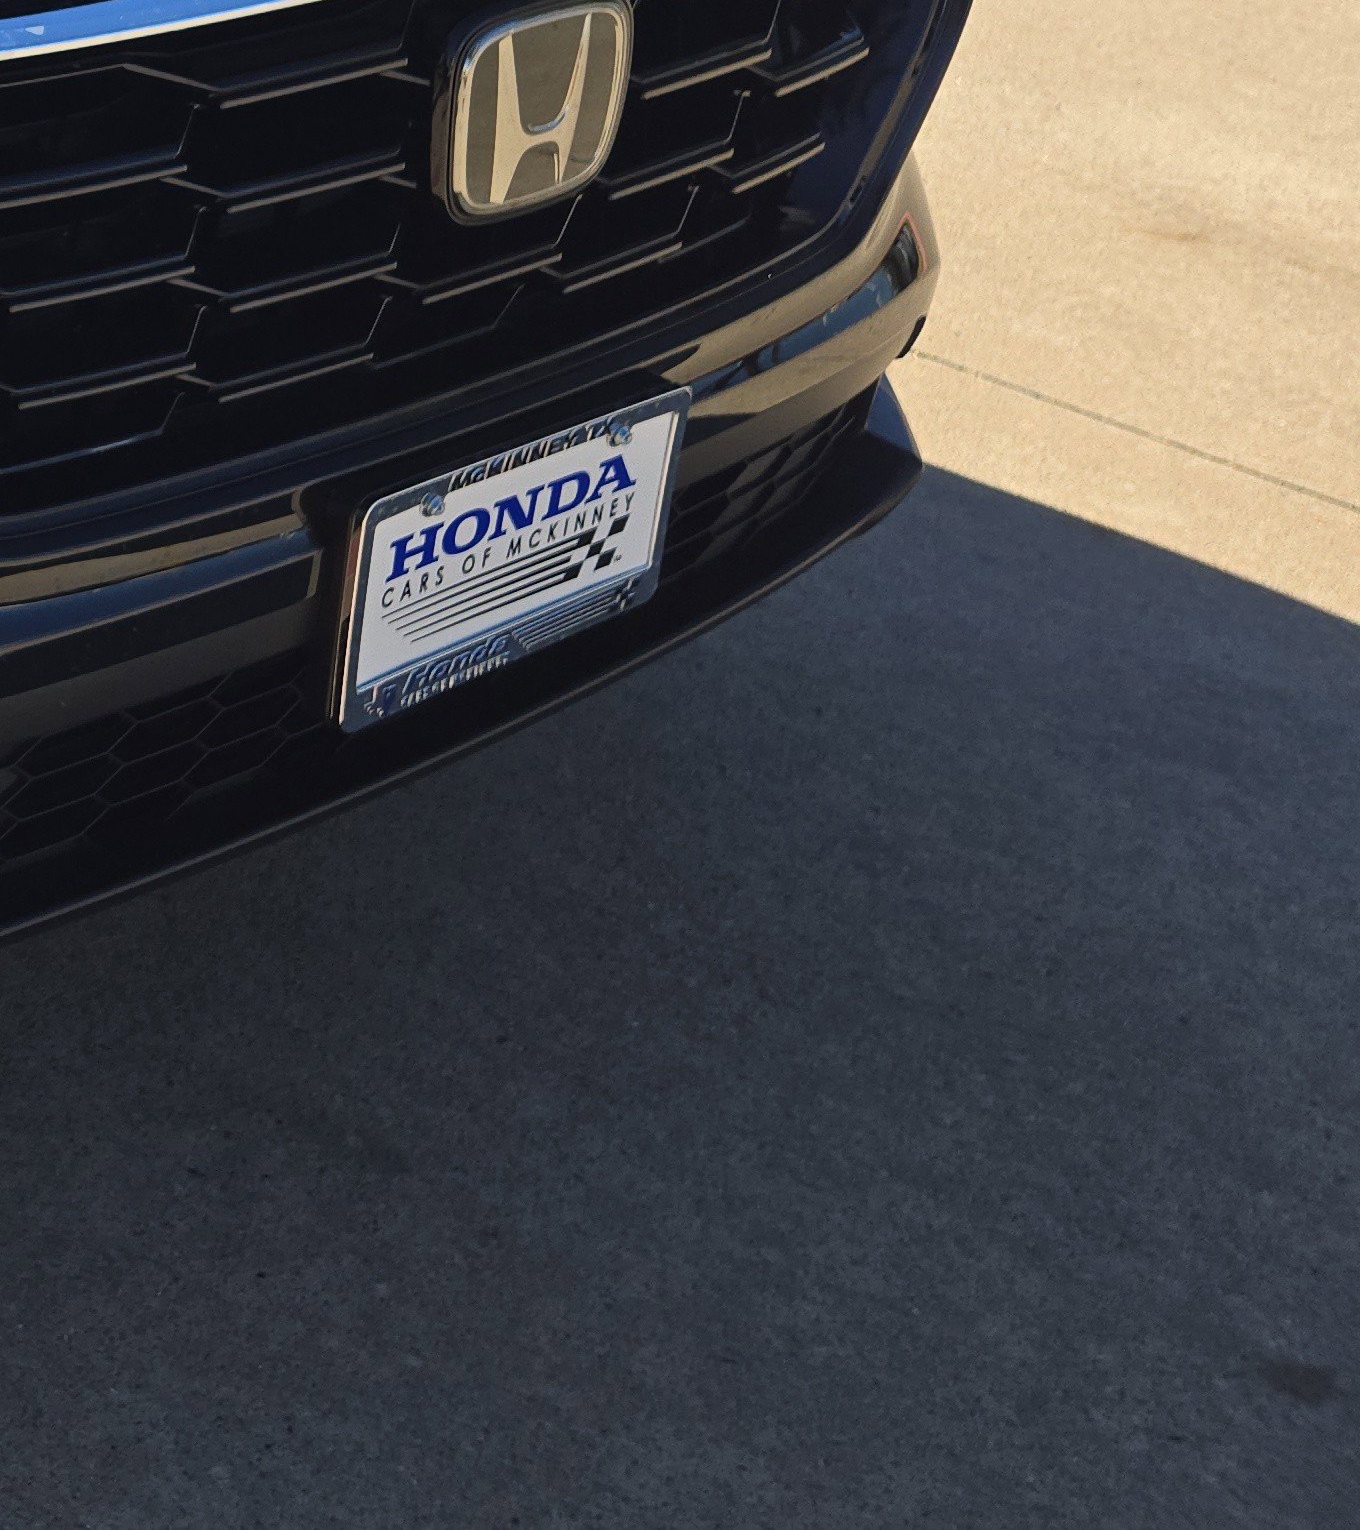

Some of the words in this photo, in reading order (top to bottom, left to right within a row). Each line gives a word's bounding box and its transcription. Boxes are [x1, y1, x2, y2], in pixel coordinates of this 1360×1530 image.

[381, 562, 445, 608] CARS
[461, 550, 492, 575] OF
[505, 492, 636, 563] MCKINNEY
[384, 453, 637, 584] HONDA
